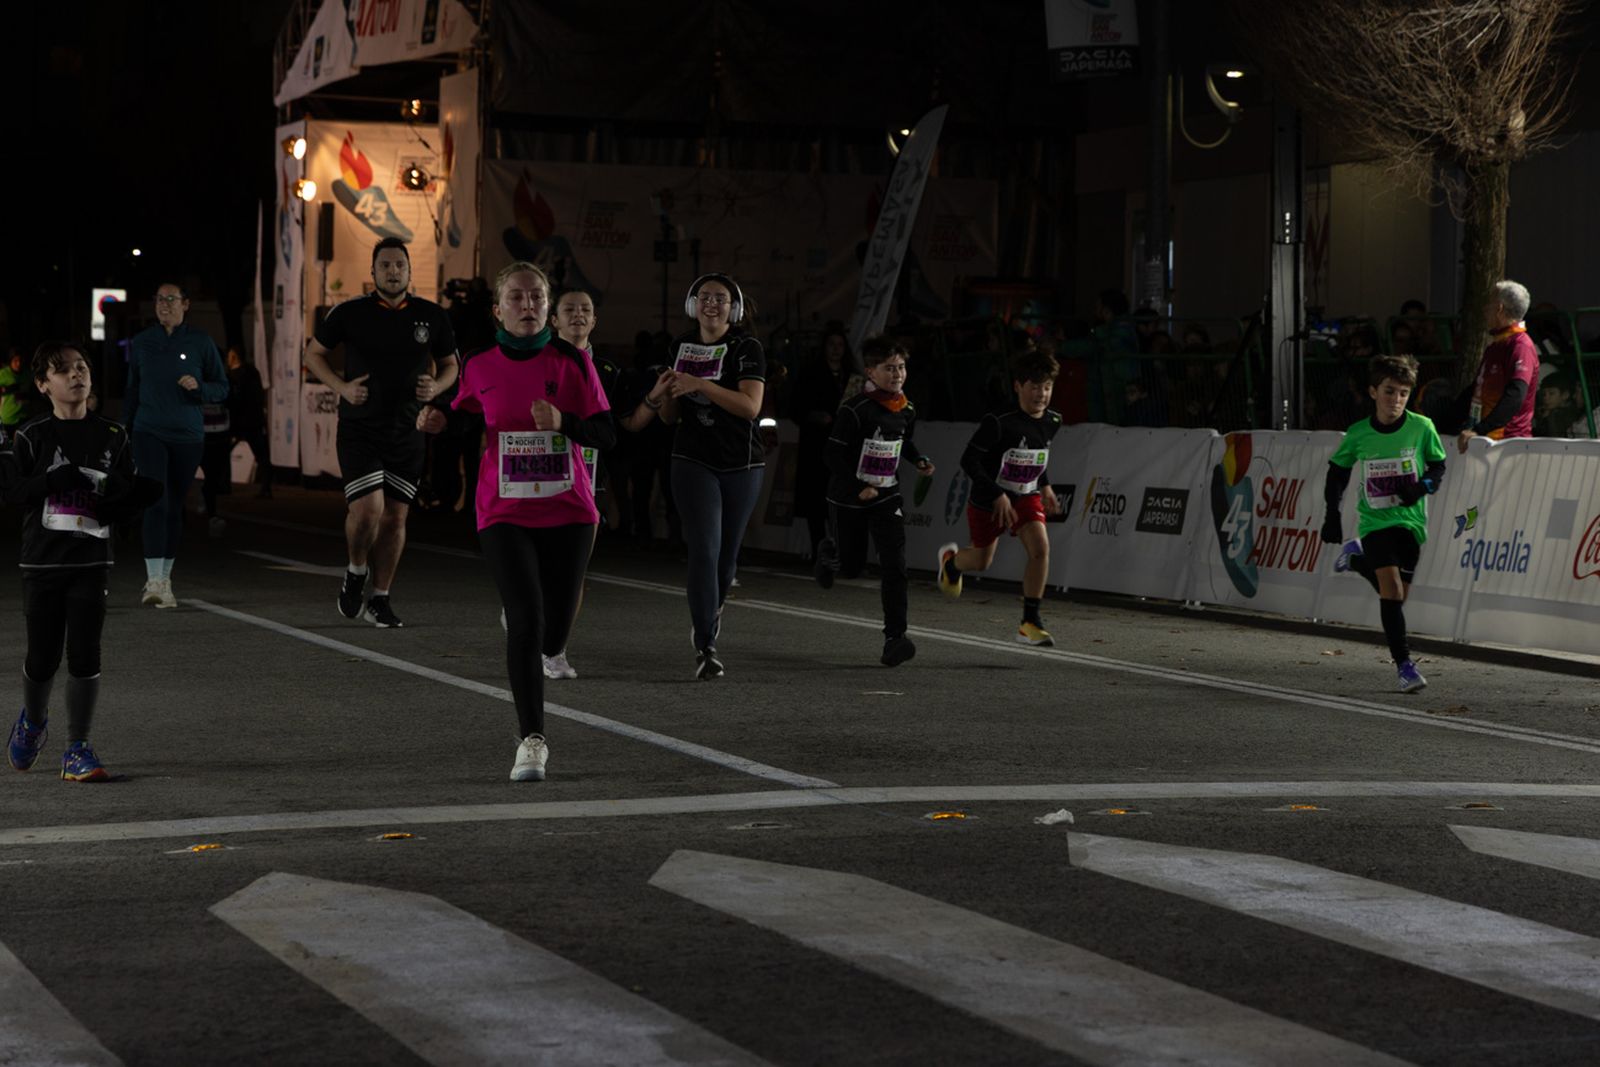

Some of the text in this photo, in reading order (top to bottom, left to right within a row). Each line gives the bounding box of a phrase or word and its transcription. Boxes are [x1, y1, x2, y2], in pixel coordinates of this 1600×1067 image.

[354, 193, 389, 227] 43
[515, 438, 536, 446] NOCHE
[508, 453, 563, 475] 14438
[1091, 493, 1126, 515] FISIO
[1146, 496, 1182, 509] DACIA
[1256, 476, 1304, 520] SAN
[1089, 515, 1122, 536] CLINIC
[1220, 494, 1252, 560] 43
[1245, 516, 1323, 572] ANTÓN
[1460, 530, 1531, 581] aqualia
